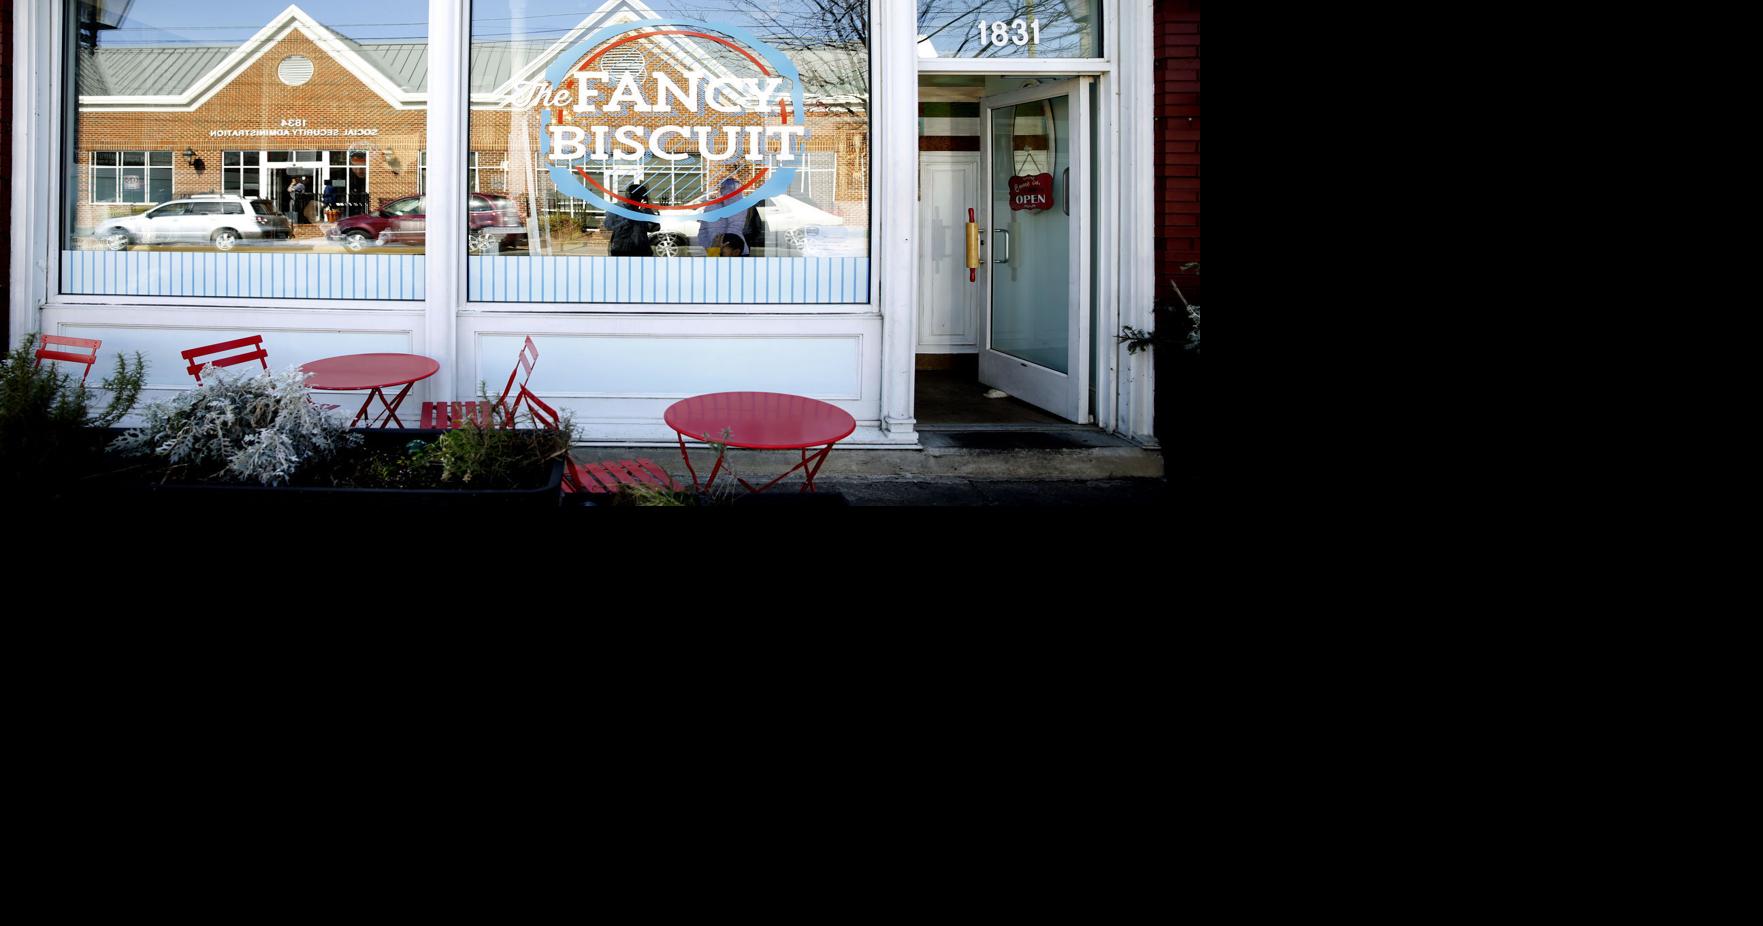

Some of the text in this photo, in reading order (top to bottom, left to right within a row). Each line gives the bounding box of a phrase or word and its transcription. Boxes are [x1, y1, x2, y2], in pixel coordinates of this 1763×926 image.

[978, 19, 1040, 47] 1831
[512, 71, 783, 113] The FANCY
[548, 125, 804, 161] BISCUIT
[1015, 193, 1046, 204] OPEN
